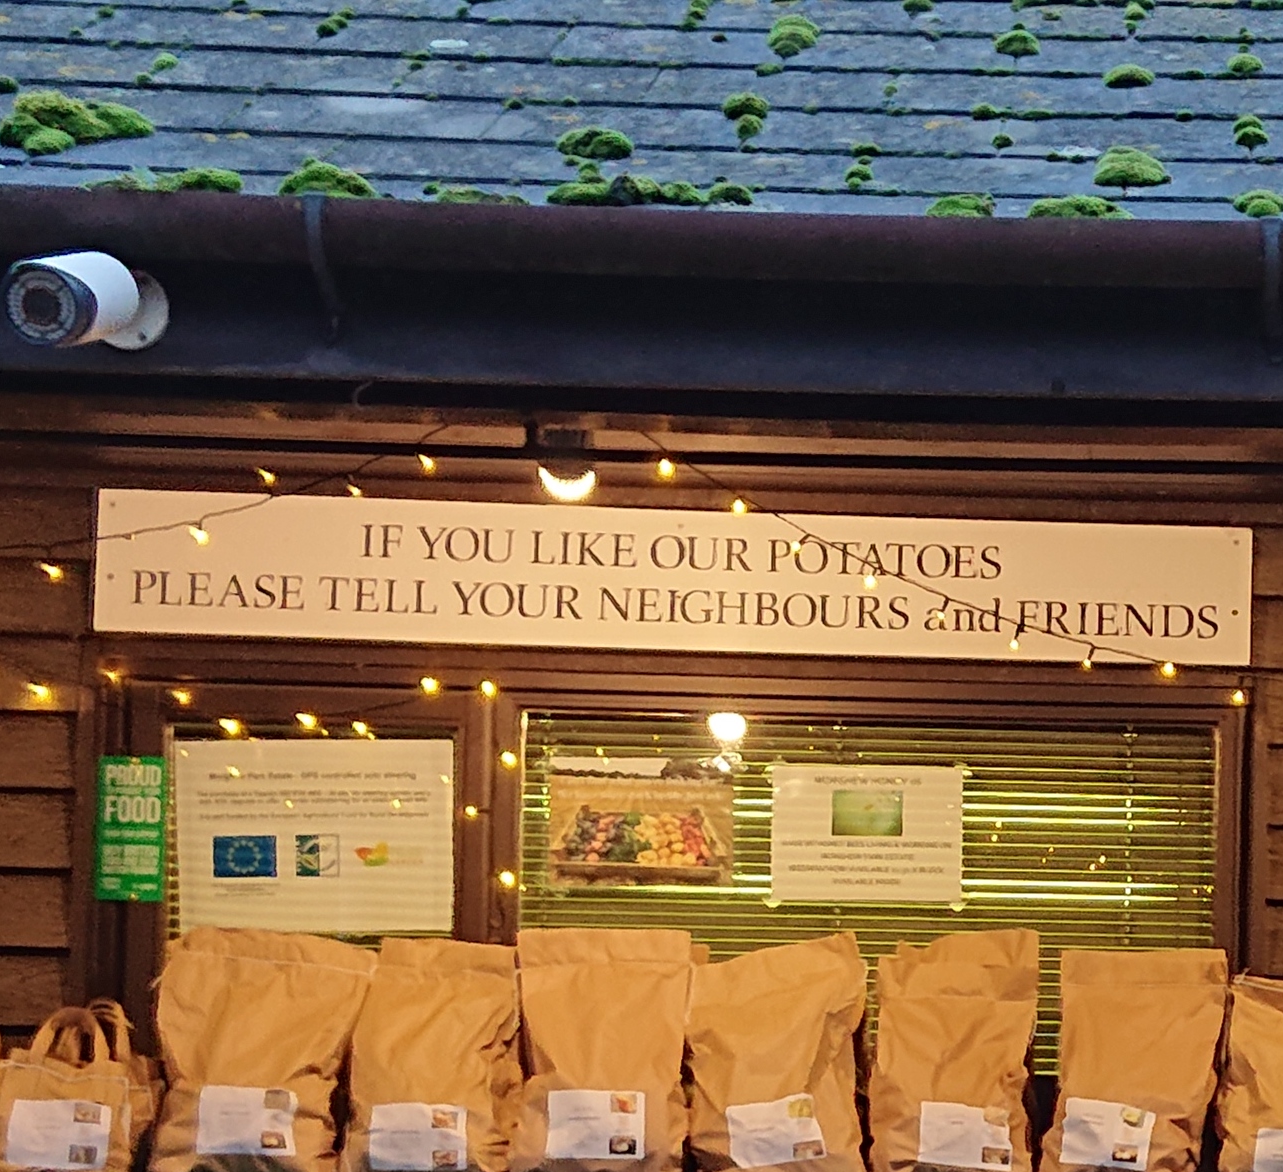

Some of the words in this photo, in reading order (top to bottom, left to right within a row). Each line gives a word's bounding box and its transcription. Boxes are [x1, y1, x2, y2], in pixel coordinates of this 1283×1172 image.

[360, 523, 404, 560] IF
[417, 526, 515, 564] YOU
[530, 530, 638, 569] LIKE
[649, 534, 749, 573] OUR
[766, 539, 1003, 580] POTATOES
[131, 569, 305, 612] PLEASE
[318, 577, 439, 616] TELL
[451, 581, 582, 621] YOUR
[597, 586, 910, 631] NEIGHBOURS
[923, 597, 1003, 634] and
[1016, 599, 1220, 641] FRIENDS
[104, 764, 162, 787] PROUD
[104, 795, 162, 823] FOOD
